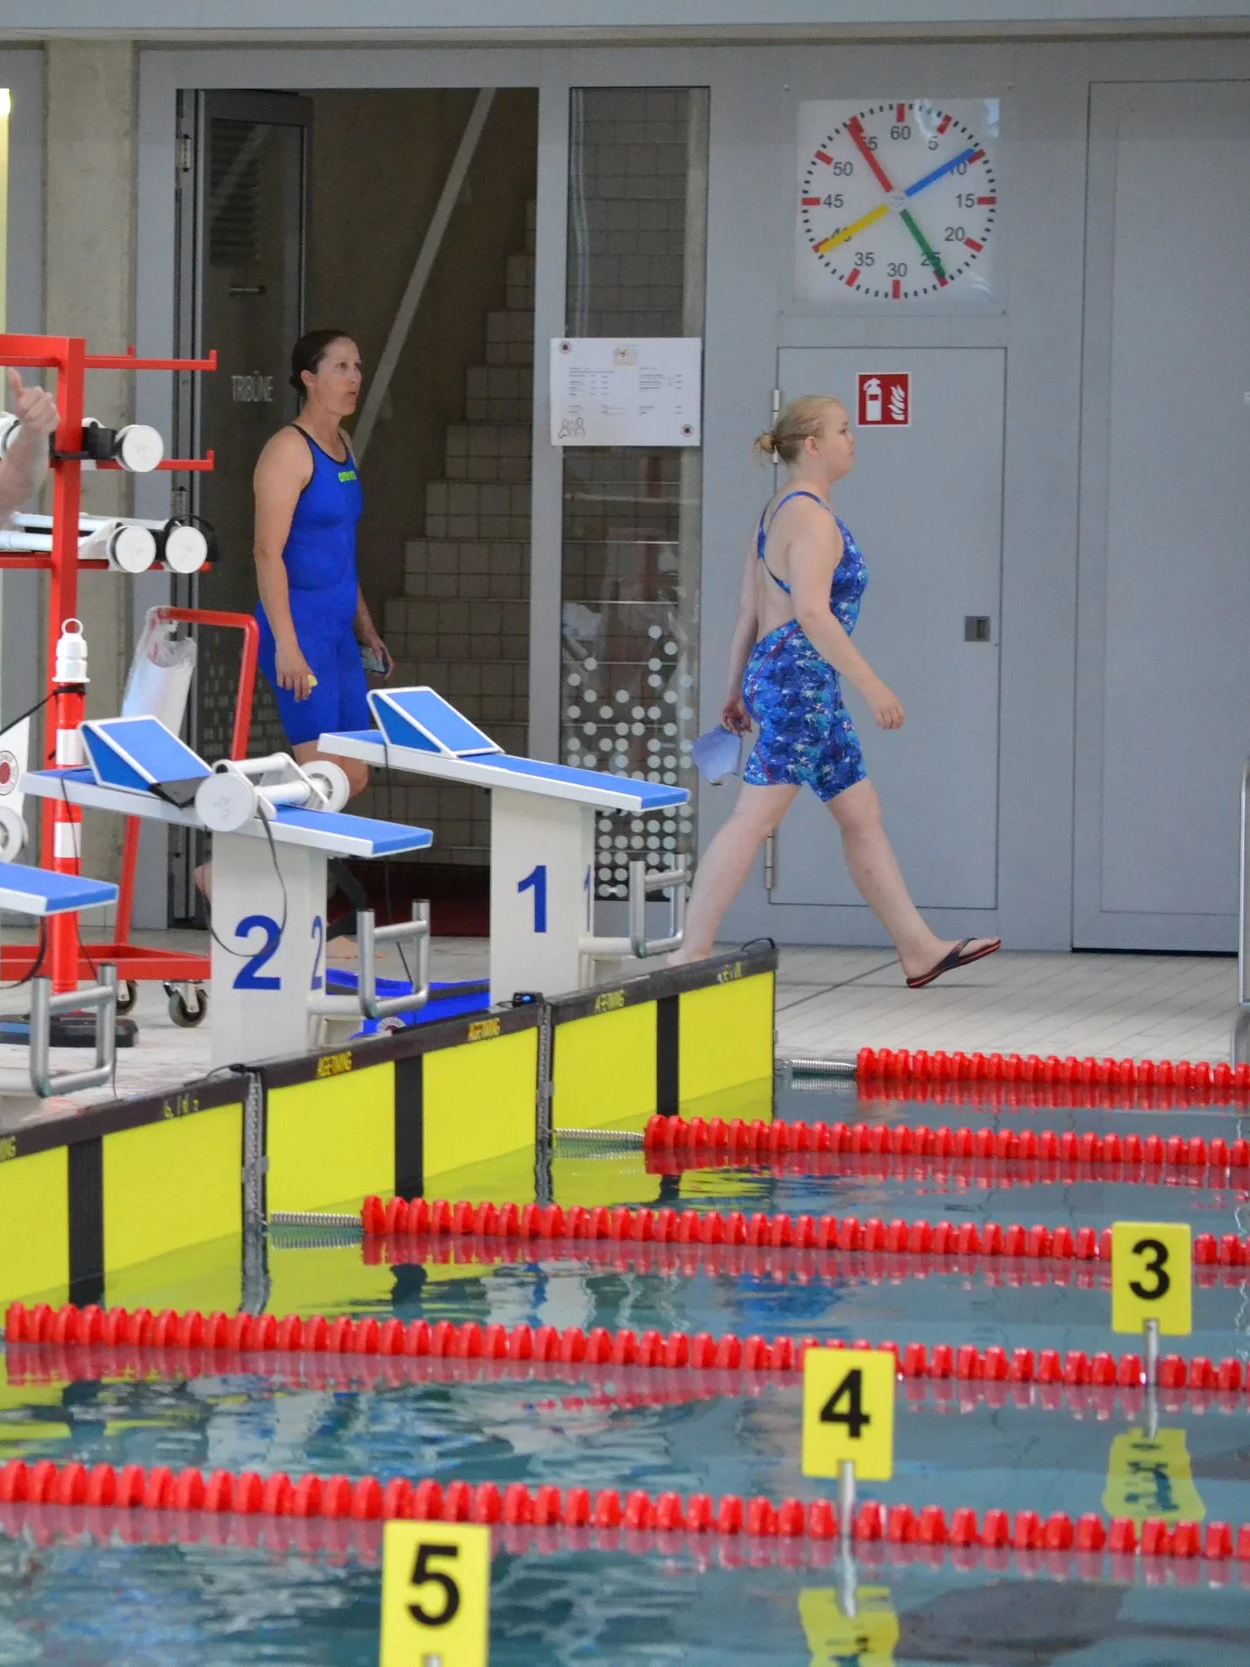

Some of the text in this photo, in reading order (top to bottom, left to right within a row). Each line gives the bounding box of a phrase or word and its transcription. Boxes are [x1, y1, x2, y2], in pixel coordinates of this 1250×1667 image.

[890, 126, 911, 140] 60
[928, 137, 938, 150] 5
[833, 162, 853, 176] 50
[823, 194, 844, 208] 45
[956, 194, 975, 208] 15
[945, 227, 965, 241] 20
[854, 252, 875, 266] 35
[887, 263, 908, 277] 30
[230, 371, 274, 402] TRIBÜNE
[517, 865, 547, 933] 1
[234, 916, 282, 990] 2
[311, 916, 323, 990] 2
[1129, 1239, 1170, 1300] 3
[819, 1369, 870, 1438] 4
[407, 1544, 461, 1626] 5
